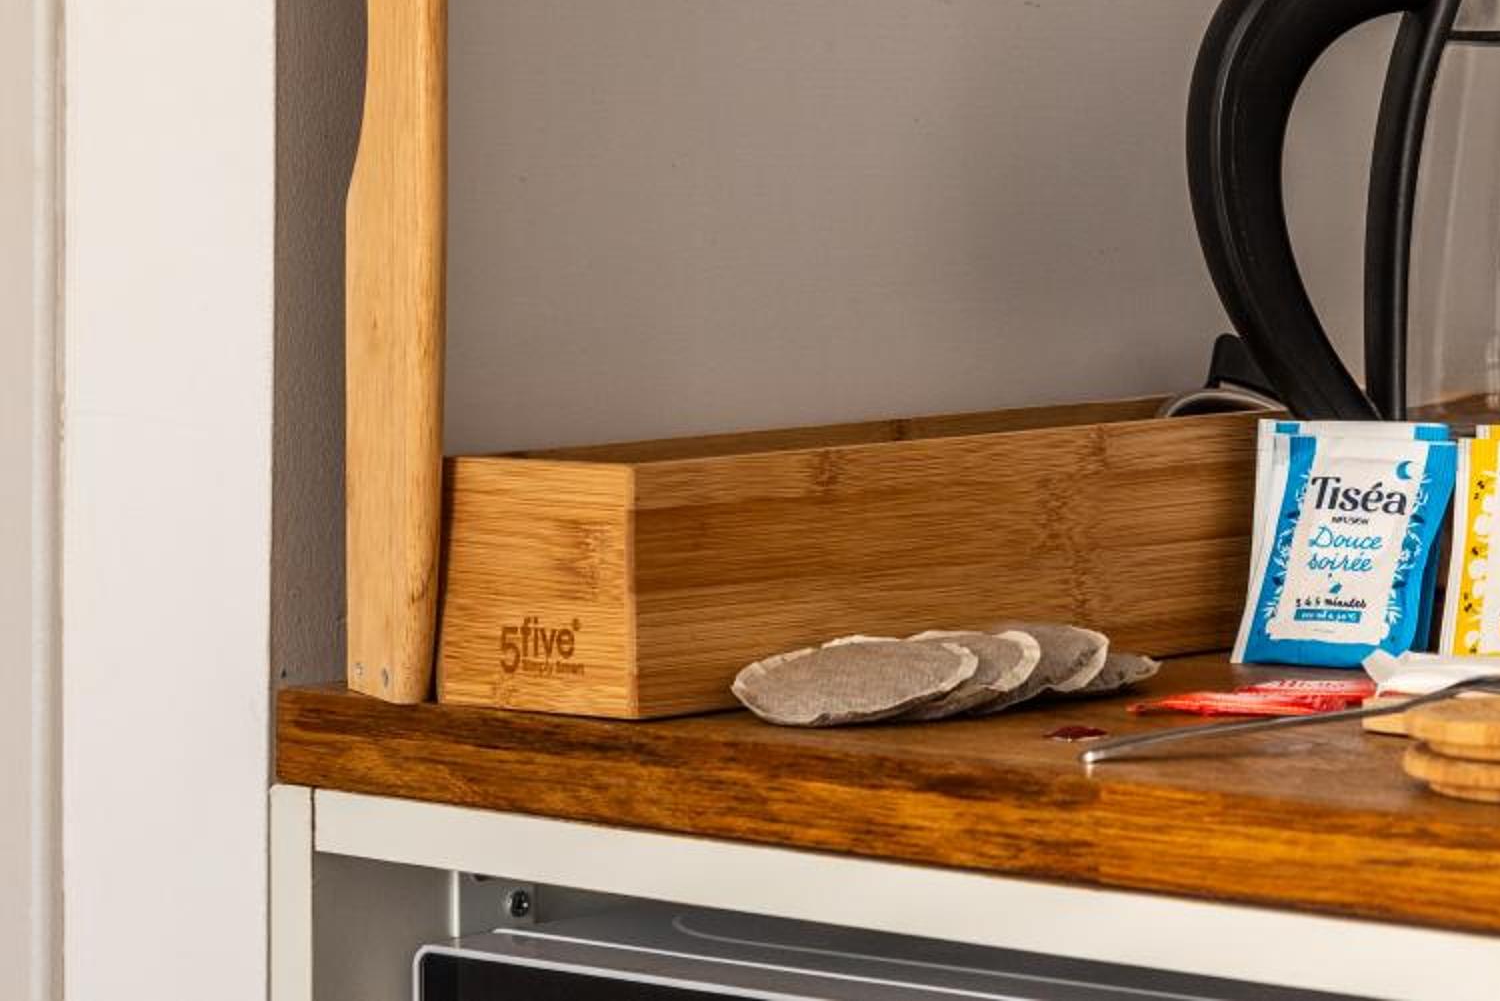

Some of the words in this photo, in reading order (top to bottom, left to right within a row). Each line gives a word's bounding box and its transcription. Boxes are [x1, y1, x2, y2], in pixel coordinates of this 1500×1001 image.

[1311, 476, 1407, 516] Tiséa
[1308, 526, 1383, 550] Douce
[1307, 552, 1373, 572] soirée
[1324, 597, 1367, 609] minutes
